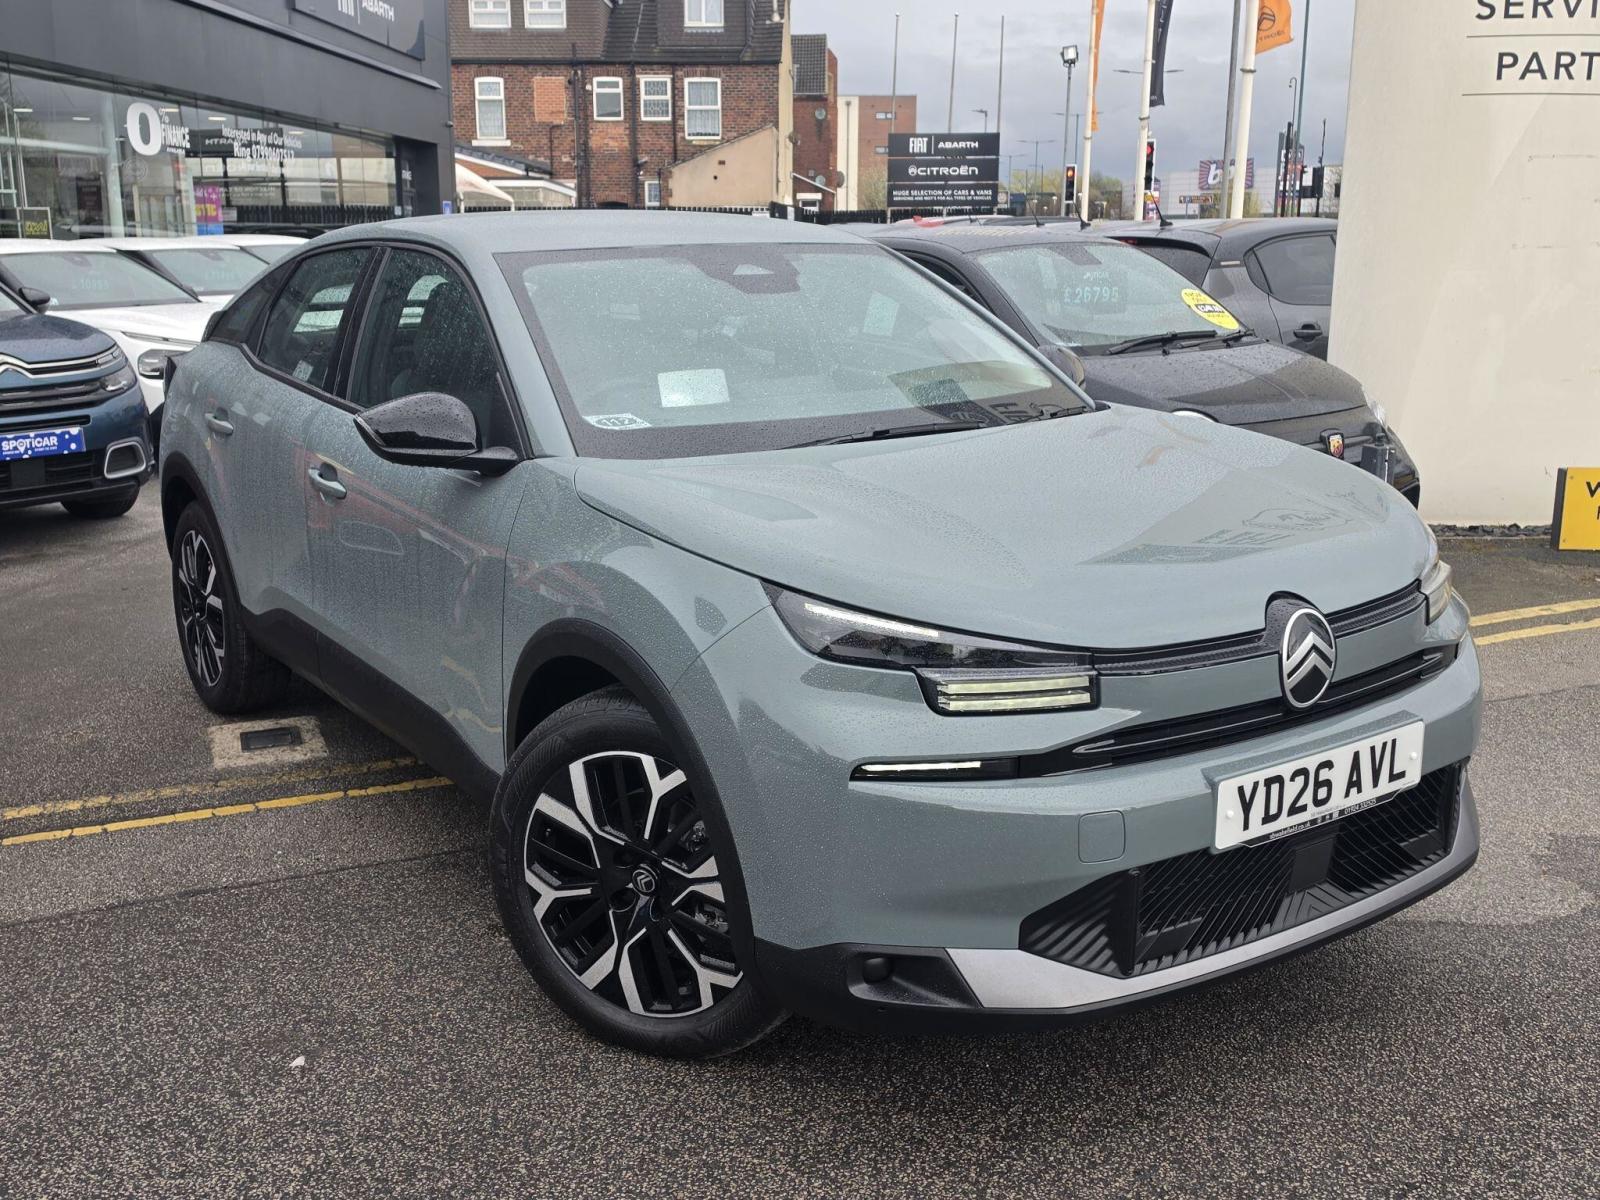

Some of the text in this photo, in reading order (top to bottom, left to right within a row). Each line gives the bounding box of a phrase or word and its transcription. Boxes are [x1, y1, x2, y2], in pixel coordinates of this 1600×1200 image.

[1475, 0, 1600, 20] SERVI
[1496, 52, 1600, 81] PART
[161, 123, 190, 148] FINANCE
[222, 124, 250, 141] Interested
[233, 141, 251, 161] Ring
[909, 137, 979, 153] FIAT ABARTH
[601, 418, 632, 427] 112
[1237, 738, 1406, 832] YD26 AVL
